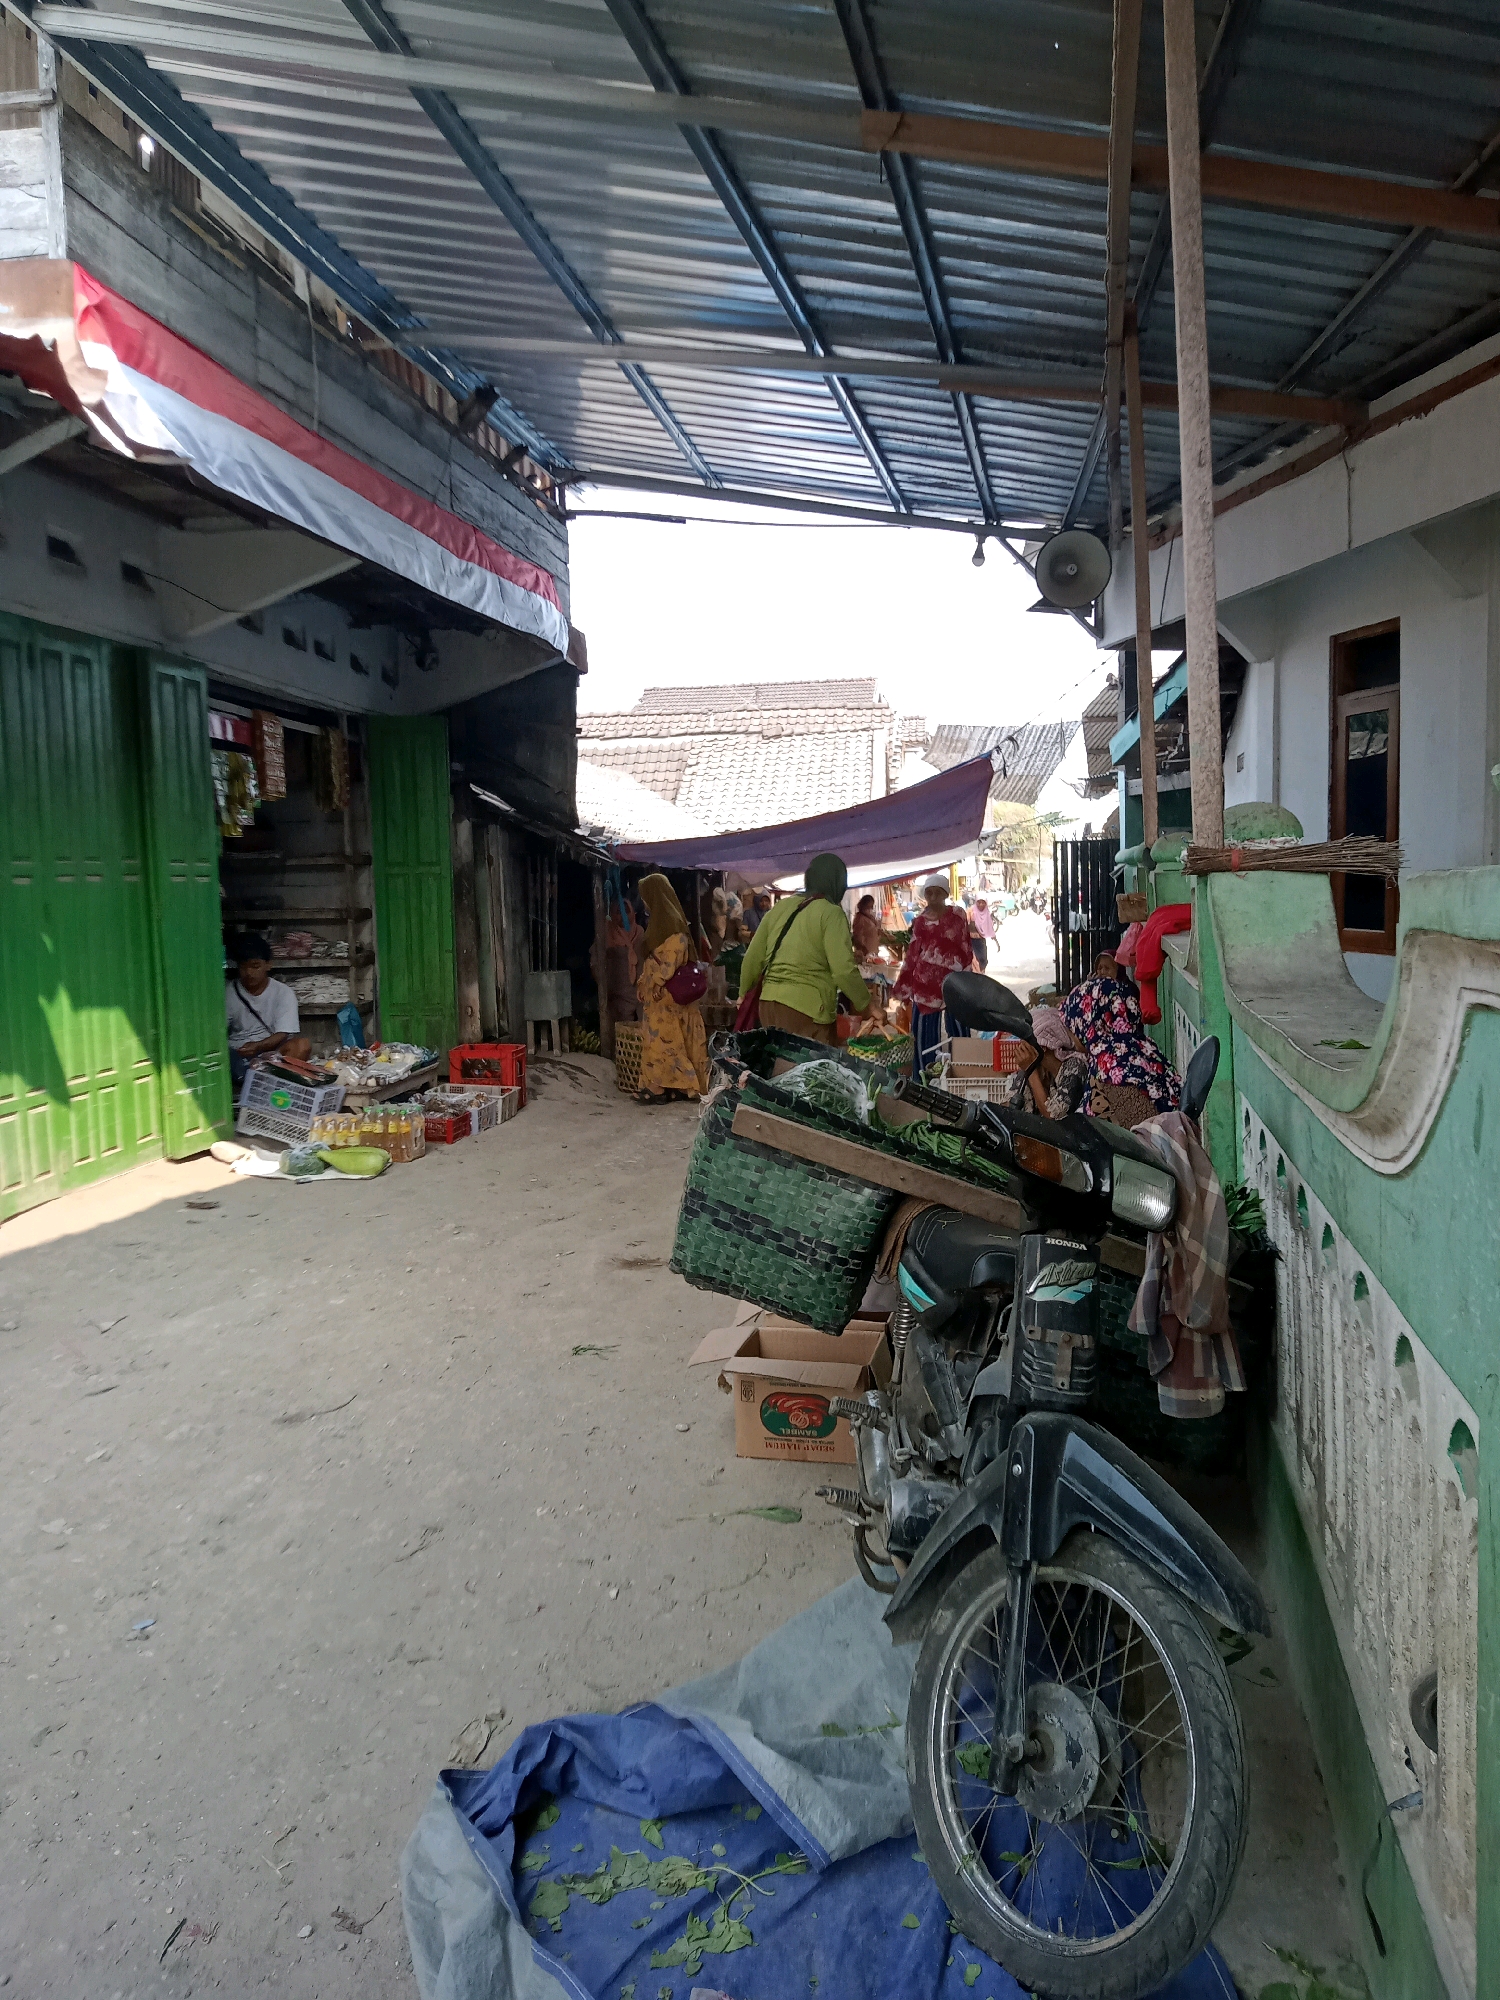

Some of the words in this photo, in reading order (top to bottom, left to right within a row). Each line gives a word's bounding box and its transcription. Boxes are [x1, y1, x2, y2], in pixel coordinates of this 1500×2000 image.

[1045, 1238, 1087, 1250] HONDA
[780, 1428, 818, 1436] SAMBEL
[765, 1441, 800, 1451] HARUM
[803, 1444, 835, 1453] SEDAP
